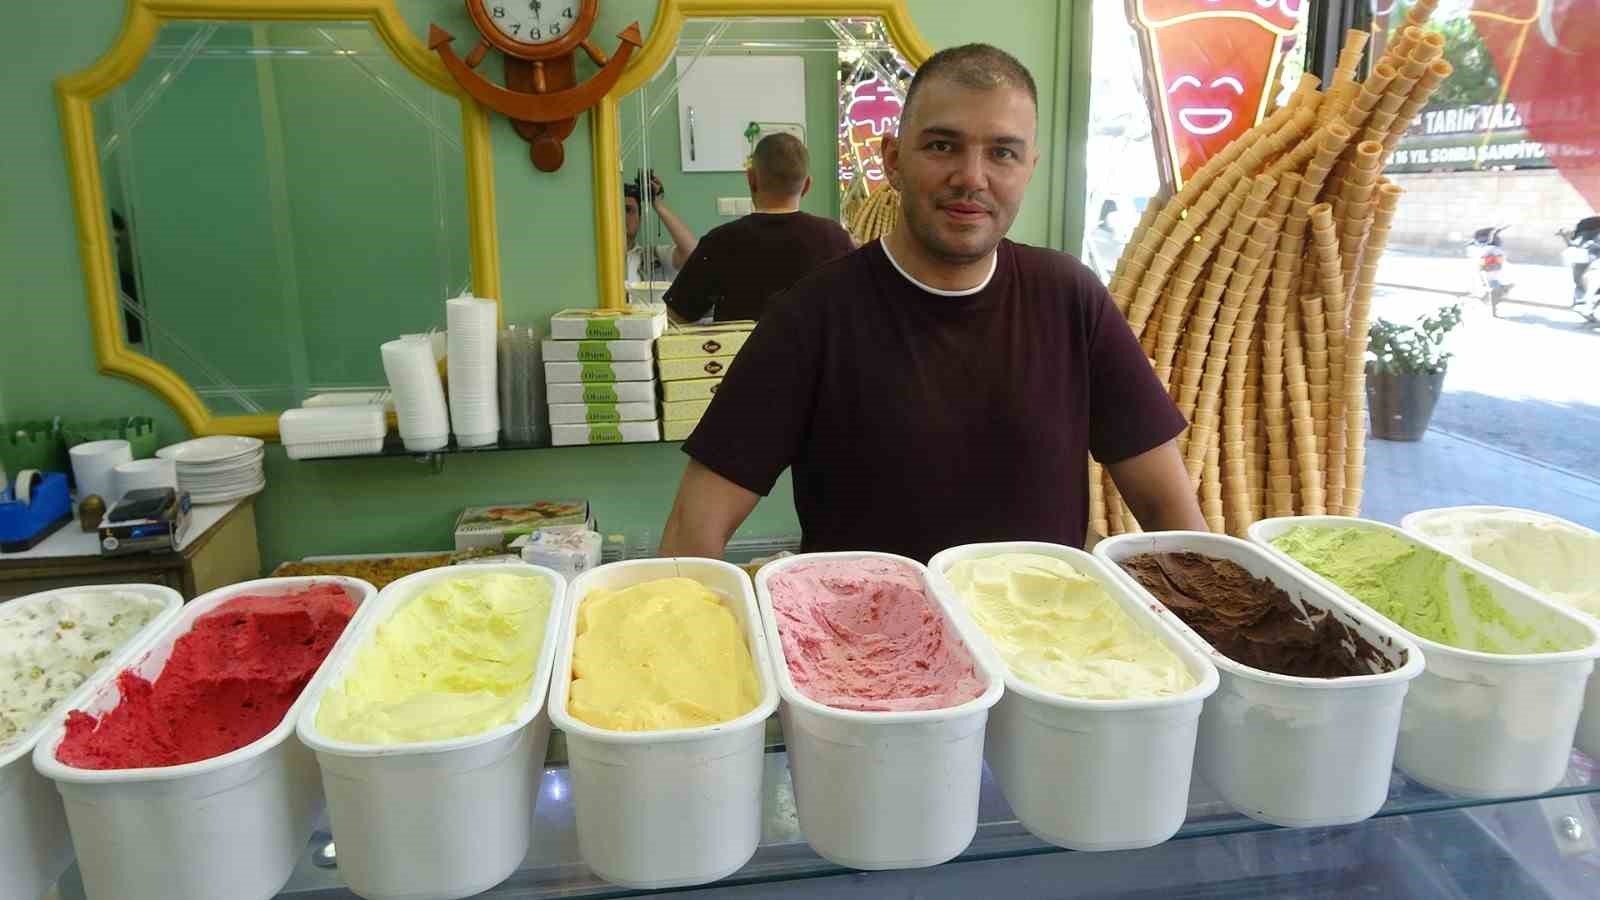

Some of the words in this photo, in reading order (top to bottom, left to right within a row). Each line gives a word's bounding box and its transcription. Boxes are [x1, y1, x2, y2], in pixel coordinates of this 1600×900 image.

[492, 7, 505, 18] 8
[562, 7, 573, 19] 4
[511, 23, 521, 35] 7
[530, 28, 541, 40] 6
[549, 22, 561, 35] 5
[1430, 146, 1476, 163] SONRA
